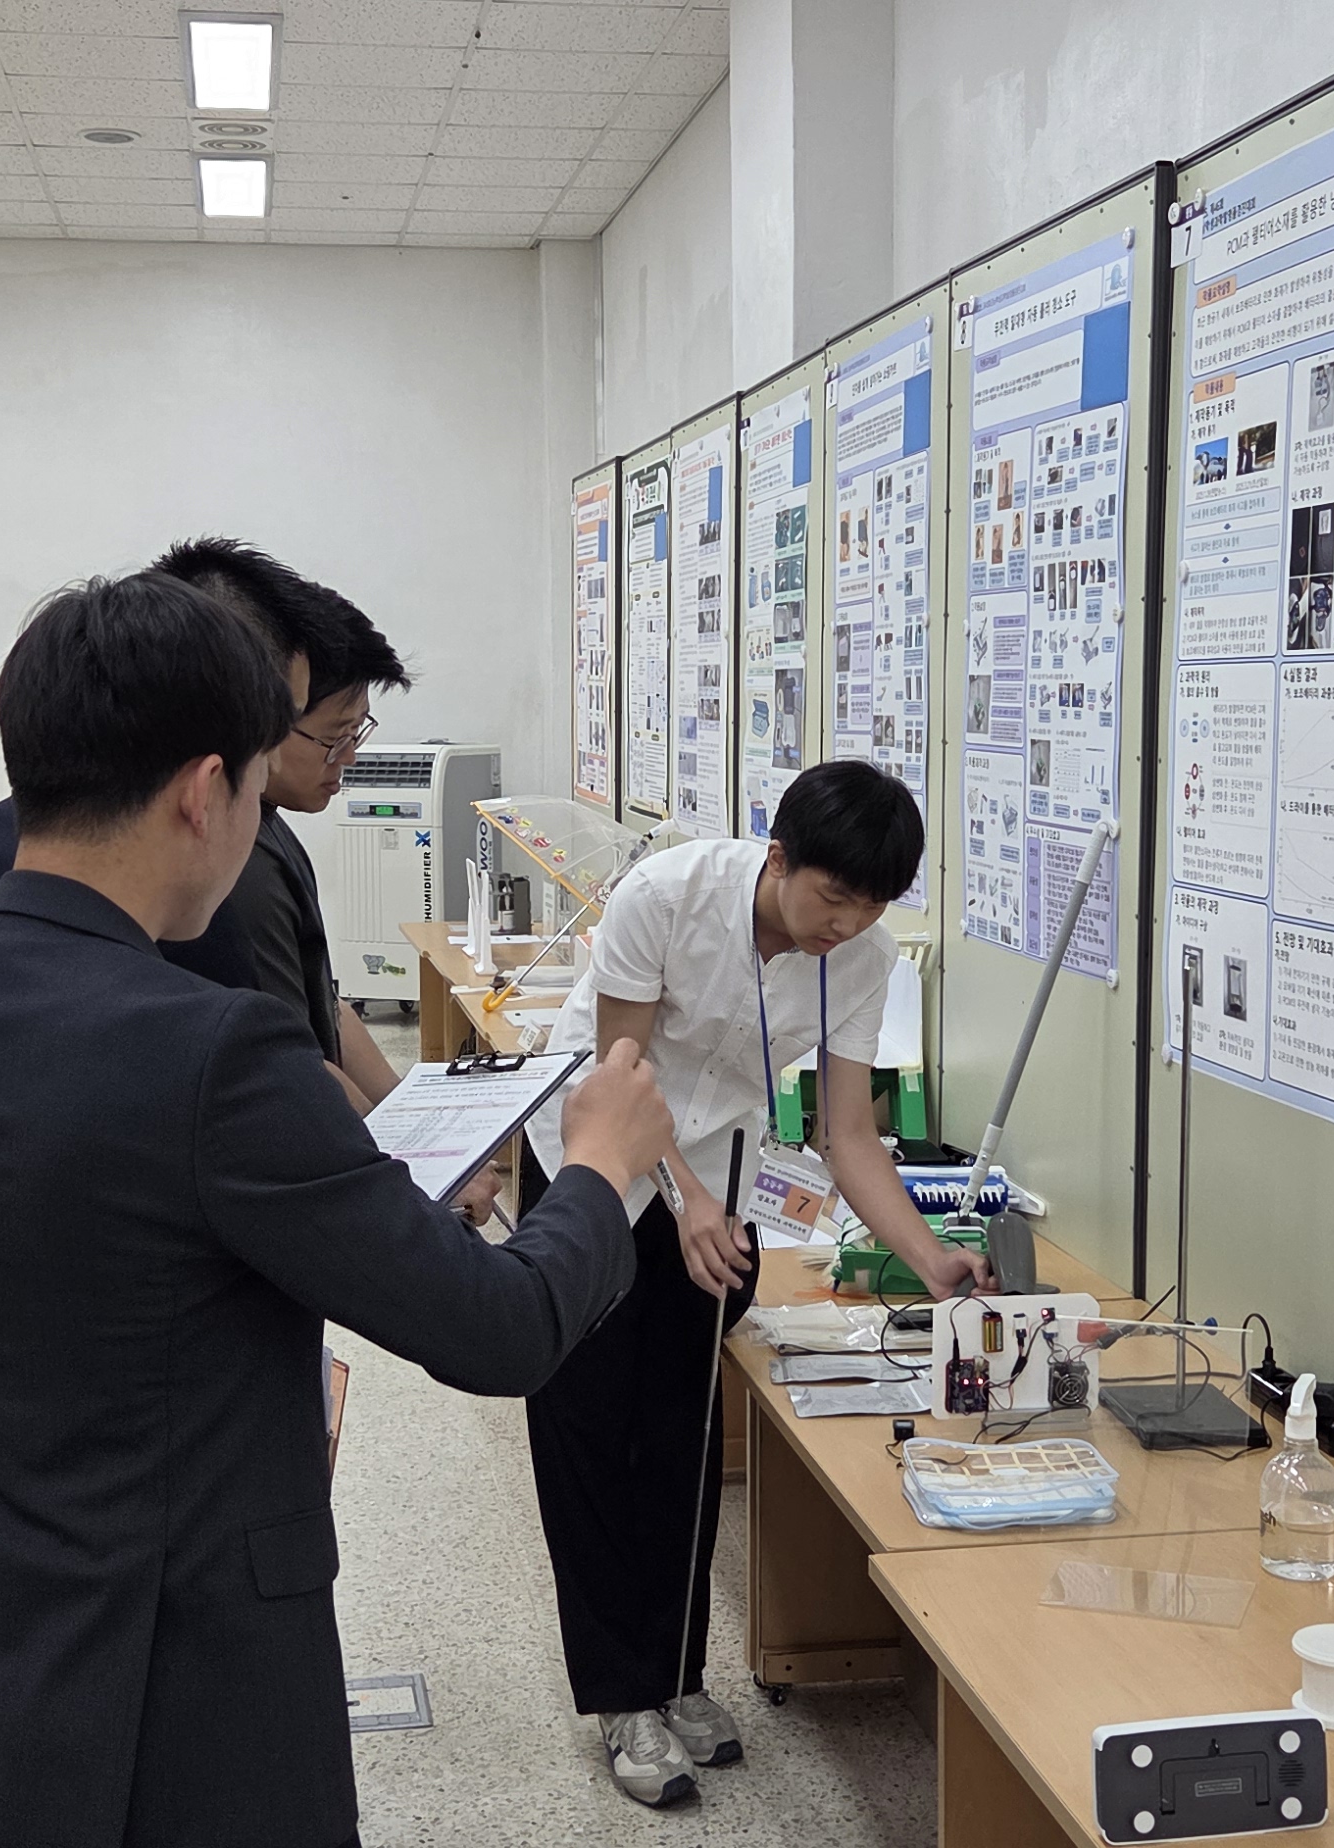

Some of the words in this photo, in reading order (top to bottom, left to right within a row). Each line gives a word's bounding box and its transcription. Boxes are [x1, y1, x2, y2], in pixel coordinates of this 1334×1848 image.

[1185, 225, 1192, 256] 7
[424, 852, 432, 923] HUMIDIFIER
[797, 1196, 810, 1213] 7
